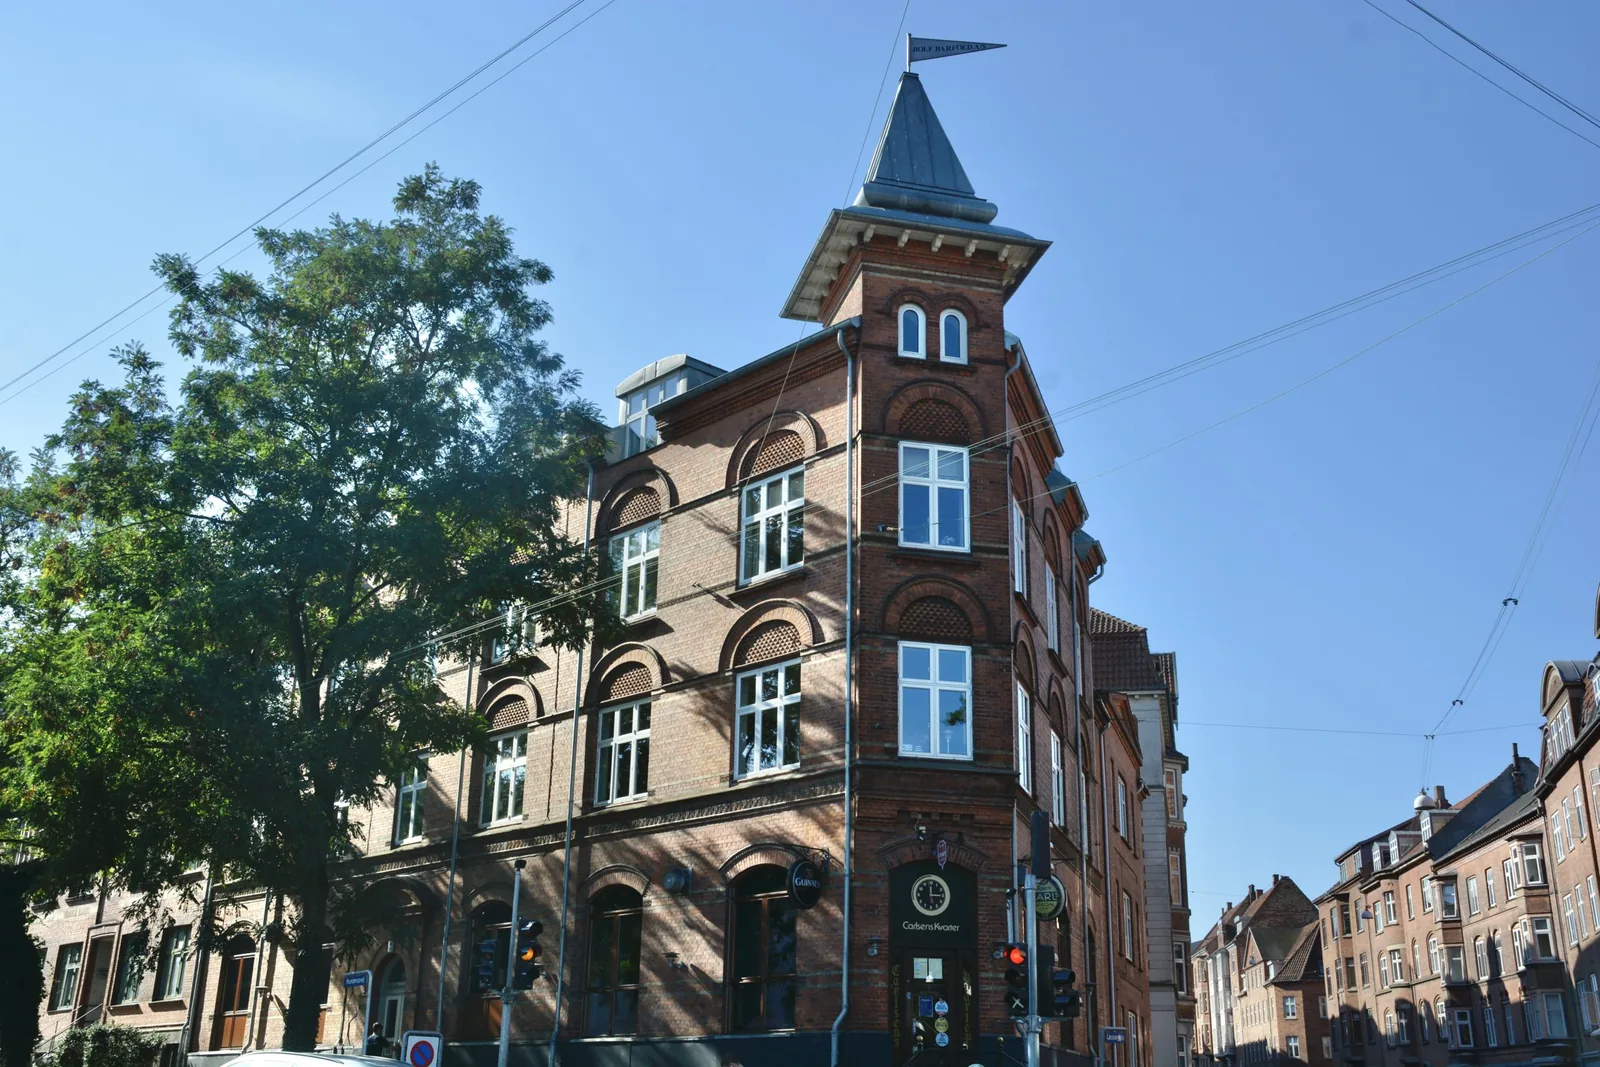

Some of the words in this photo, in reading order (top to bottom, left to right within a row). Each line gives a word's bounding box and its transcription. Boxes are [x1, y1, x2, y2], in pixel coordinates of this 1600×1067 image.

[935, 44, 972, 52] BARFOED
[902, 921, 933, 930] Carlsens
[934, 922, 960, 931] Kvarter
